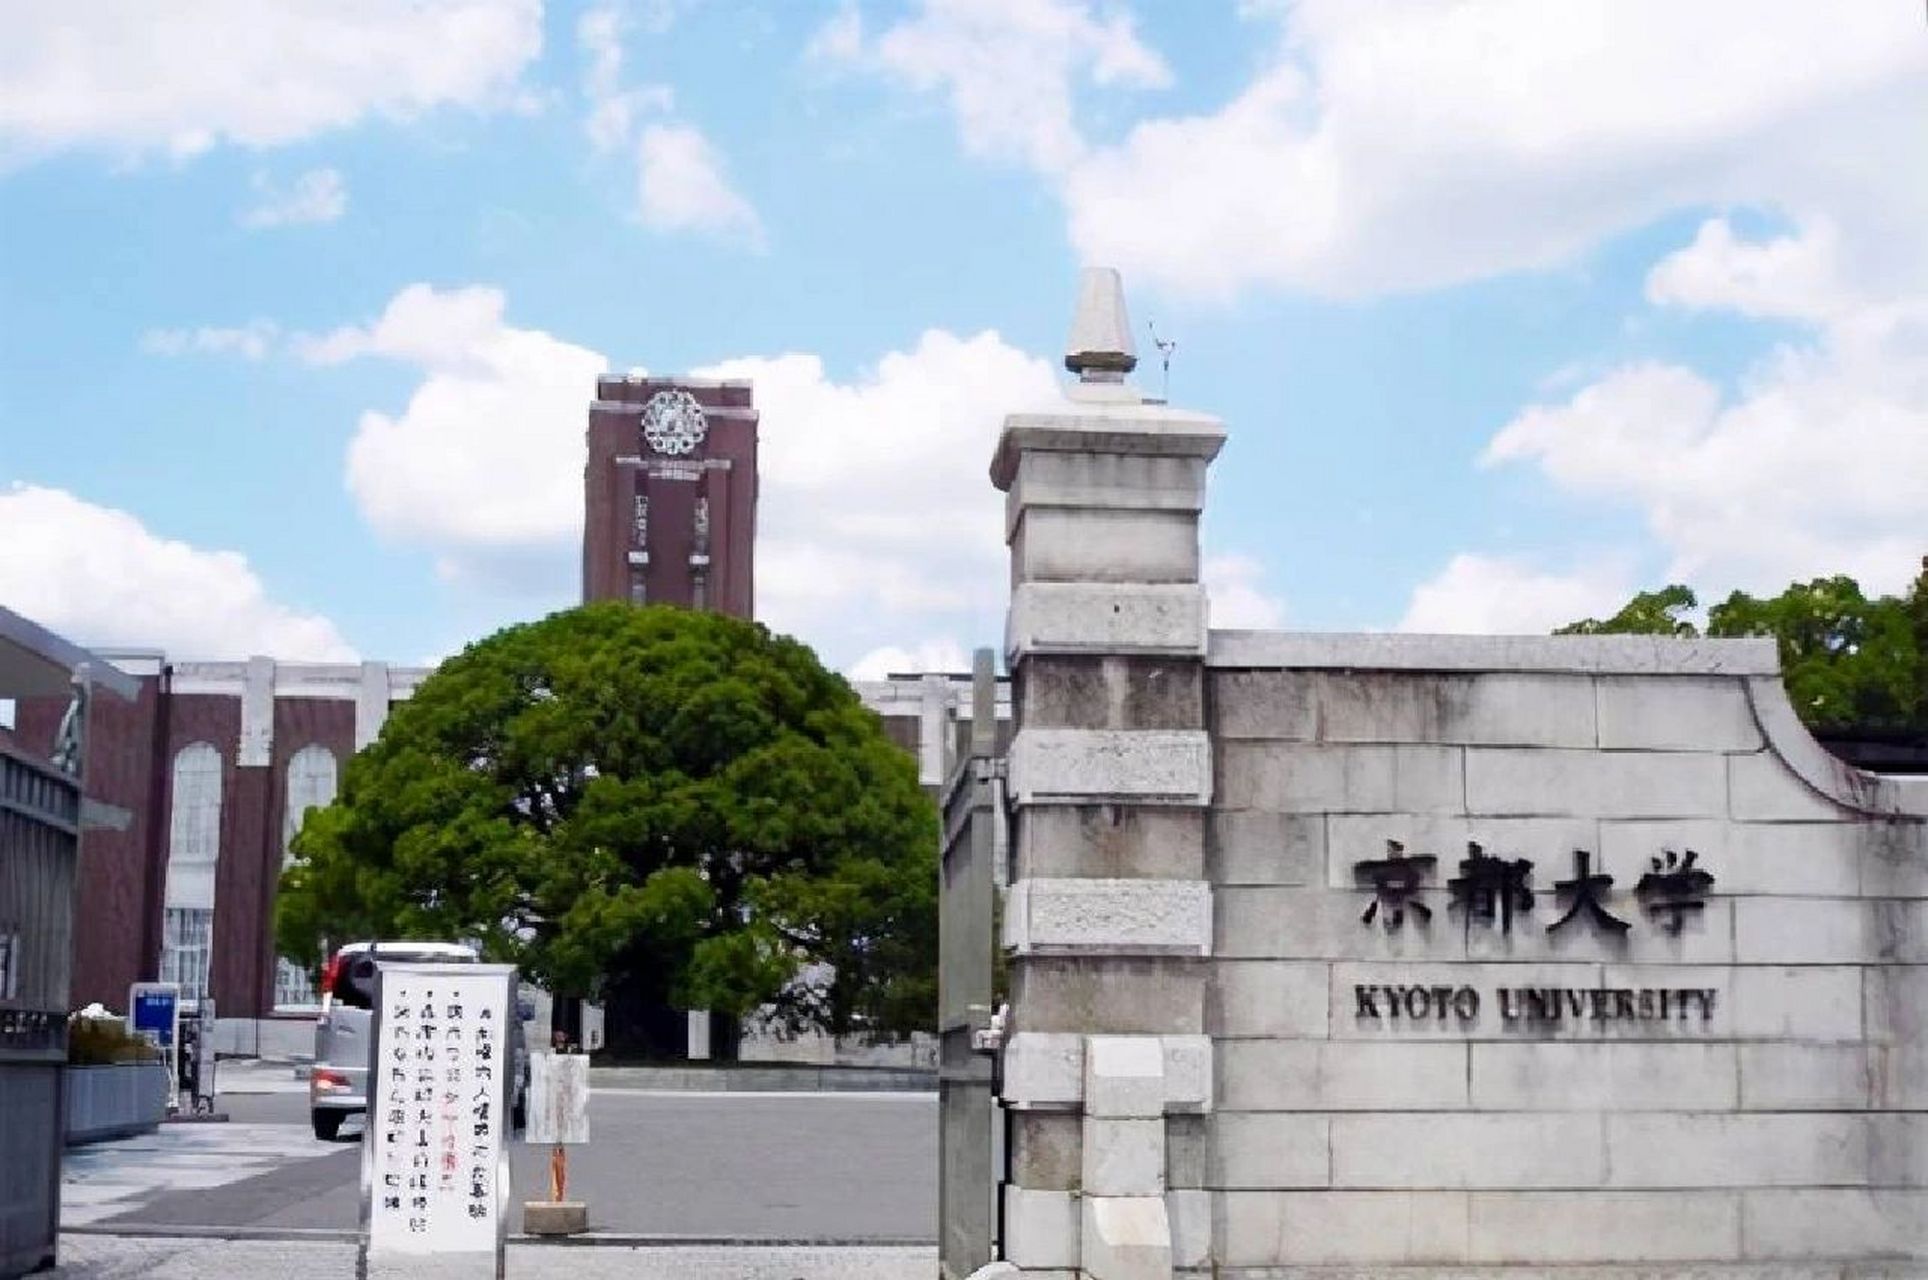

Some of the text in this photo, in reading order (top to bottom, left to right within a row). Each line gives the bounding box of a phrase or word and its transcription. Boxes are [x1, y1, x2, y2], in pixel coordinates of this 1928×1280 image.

[1353, 839, 1715, 936] 京都大学
[1355, 984, 1718, 1021] KYOTO UNIVERSITY
